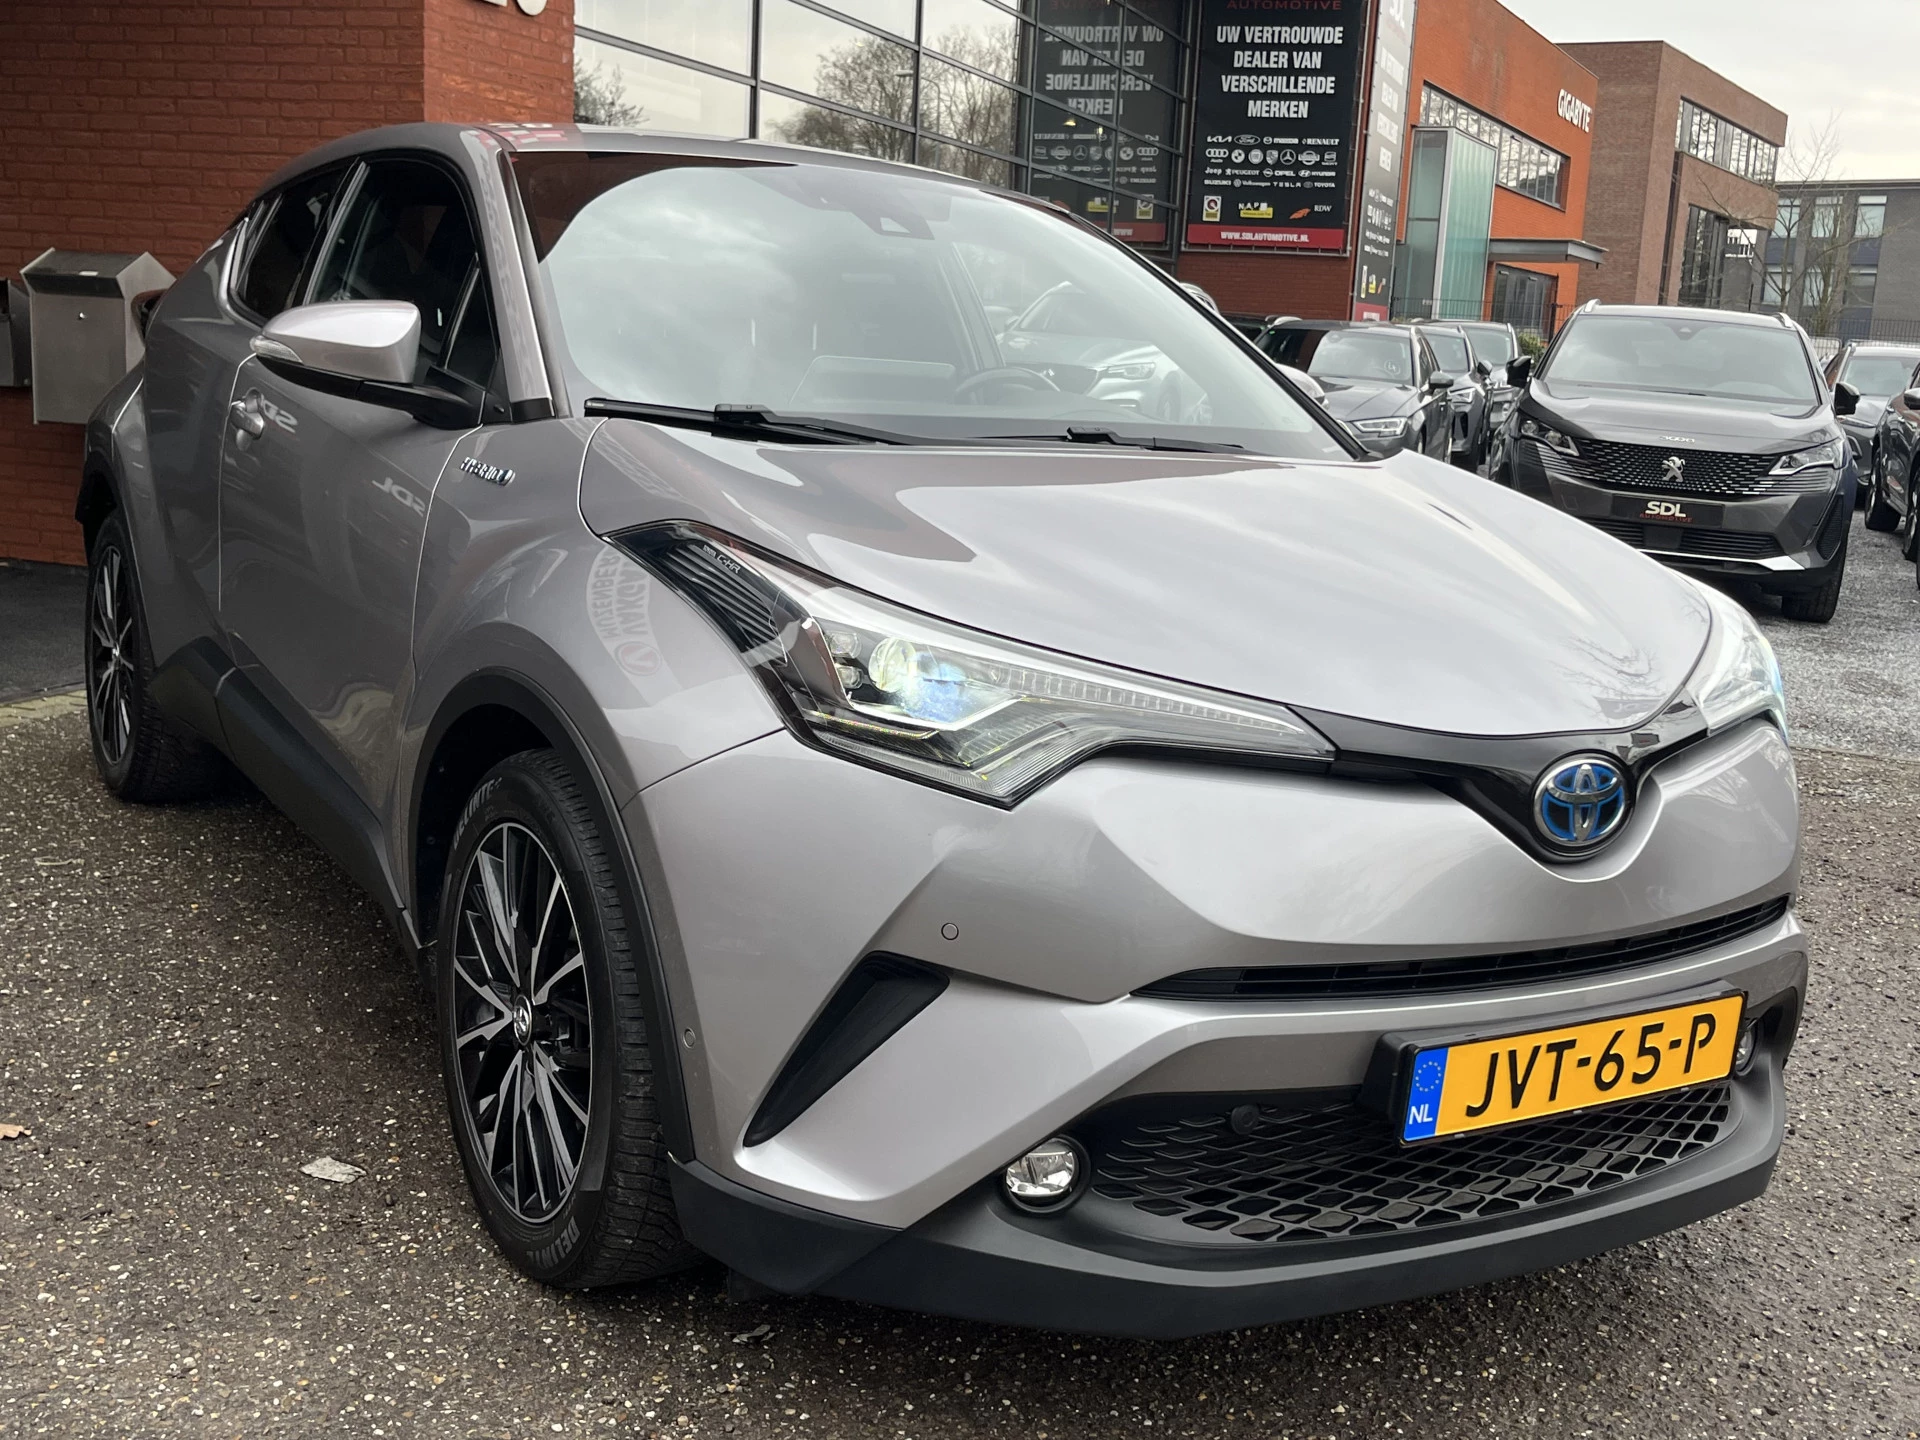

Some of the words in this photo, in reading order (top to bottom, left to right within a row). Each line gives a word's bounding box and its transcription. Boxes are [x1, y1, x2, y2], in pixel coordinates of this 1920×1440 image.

[1226, 0, 1342, 10] AUTOMOTIVE
[1216, 26, 1241, 43] UW
[1244, 26, 1344, 44] VERTROUWDE
[1233, 50, 1289, 69] DEALER
[1292, 51, 1322, 69] VAN
[1221, 75, 1336, 94] VERSCHILLENDE
[1247, 100, 1309, 118] MERKEN
[1557, 88, 1593, 133] GIGABYTE
[1306, 138, 1340, 146] RENAULT
[1205, 166, 1222, 176] Jeep
[1314, 204, 1332, 212] RDW
[1645, 501, 1686, 517] SDL
[1465, 1013, 1716, 1117] JVT-65-P
[1408, 1103, 1434, 1125] NL
